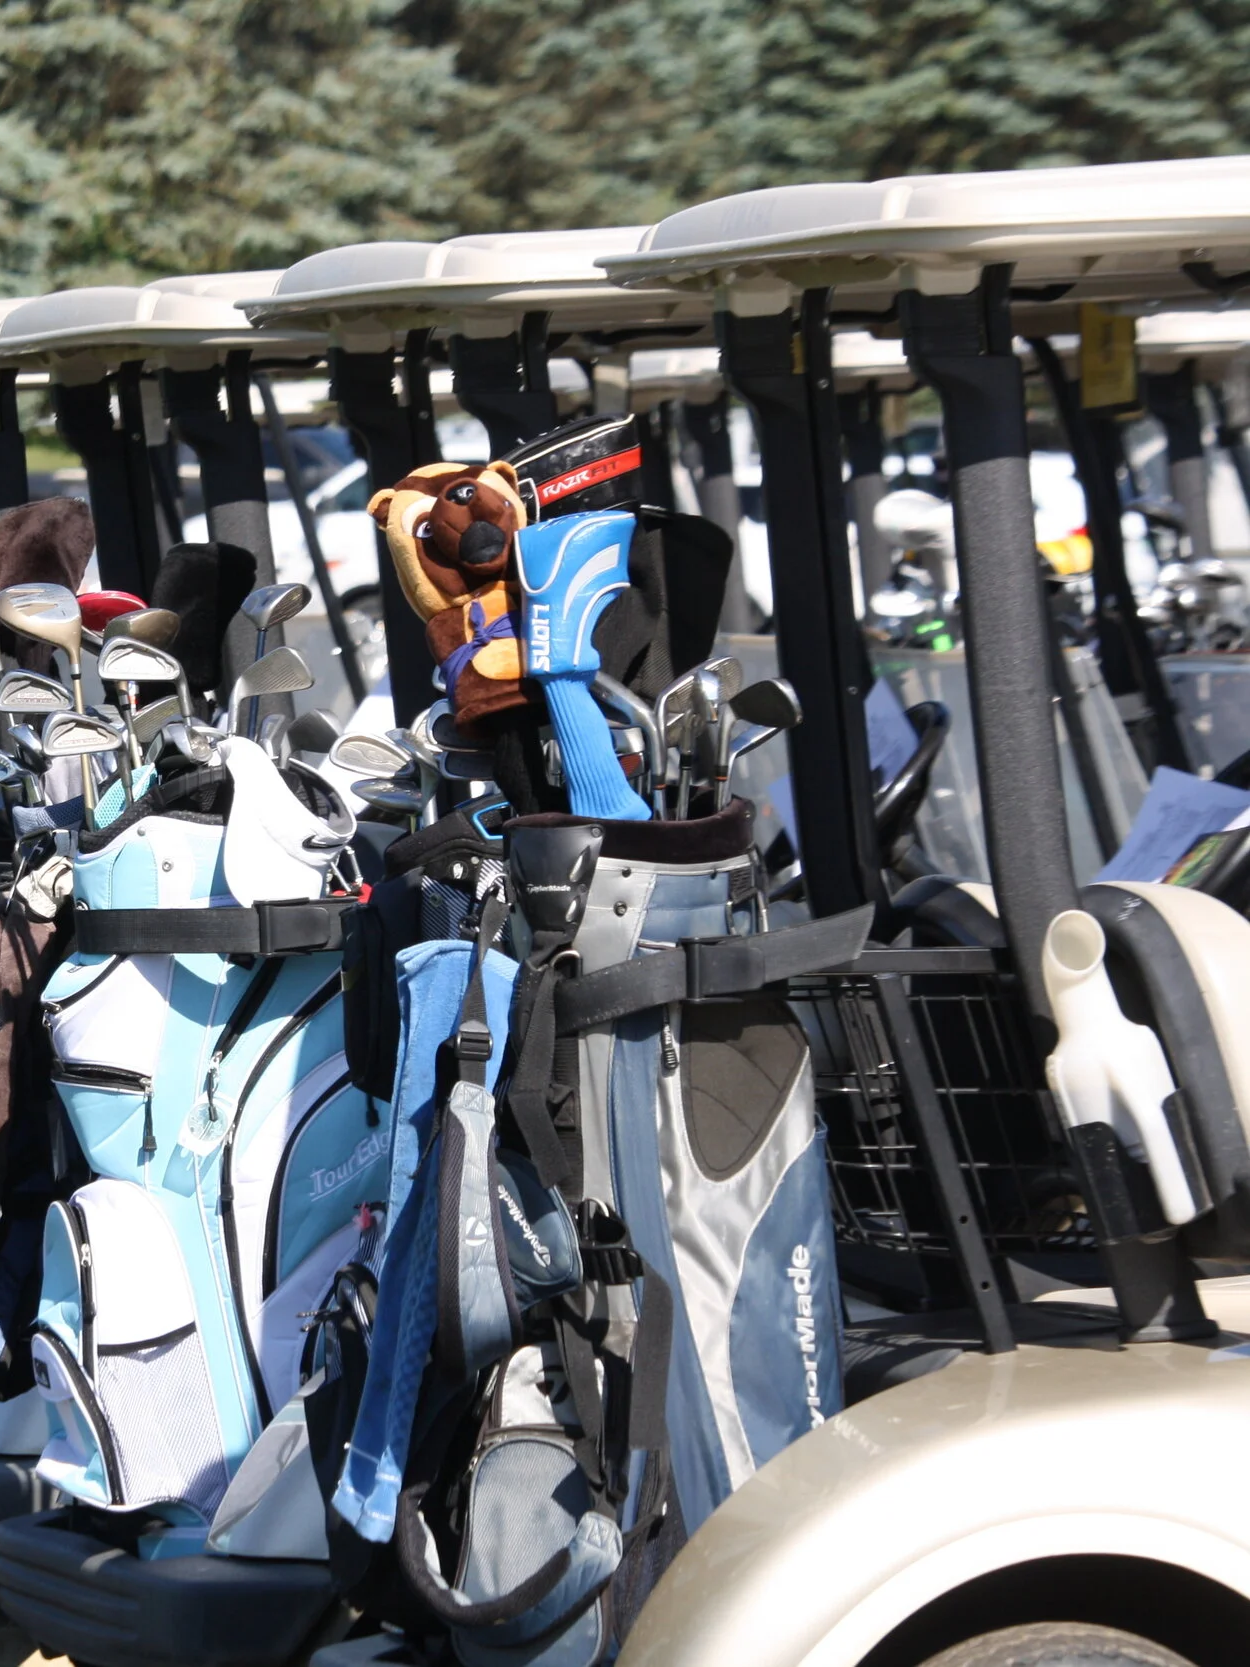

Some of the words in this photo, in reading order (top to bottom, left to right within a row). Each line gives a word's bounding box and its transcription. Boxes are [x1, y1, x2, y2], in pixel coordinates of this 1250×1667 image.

[542, 469, 590, 498] RAZR
[591, 461, 618, 478] FIT
[531, 604, 550, 672] Lions
[309, 1131, 391, 1195] TourEdg
[497, 1184, 551, 1268] TaylorMade
[787, 1244, 825, 1430] ylorMade
